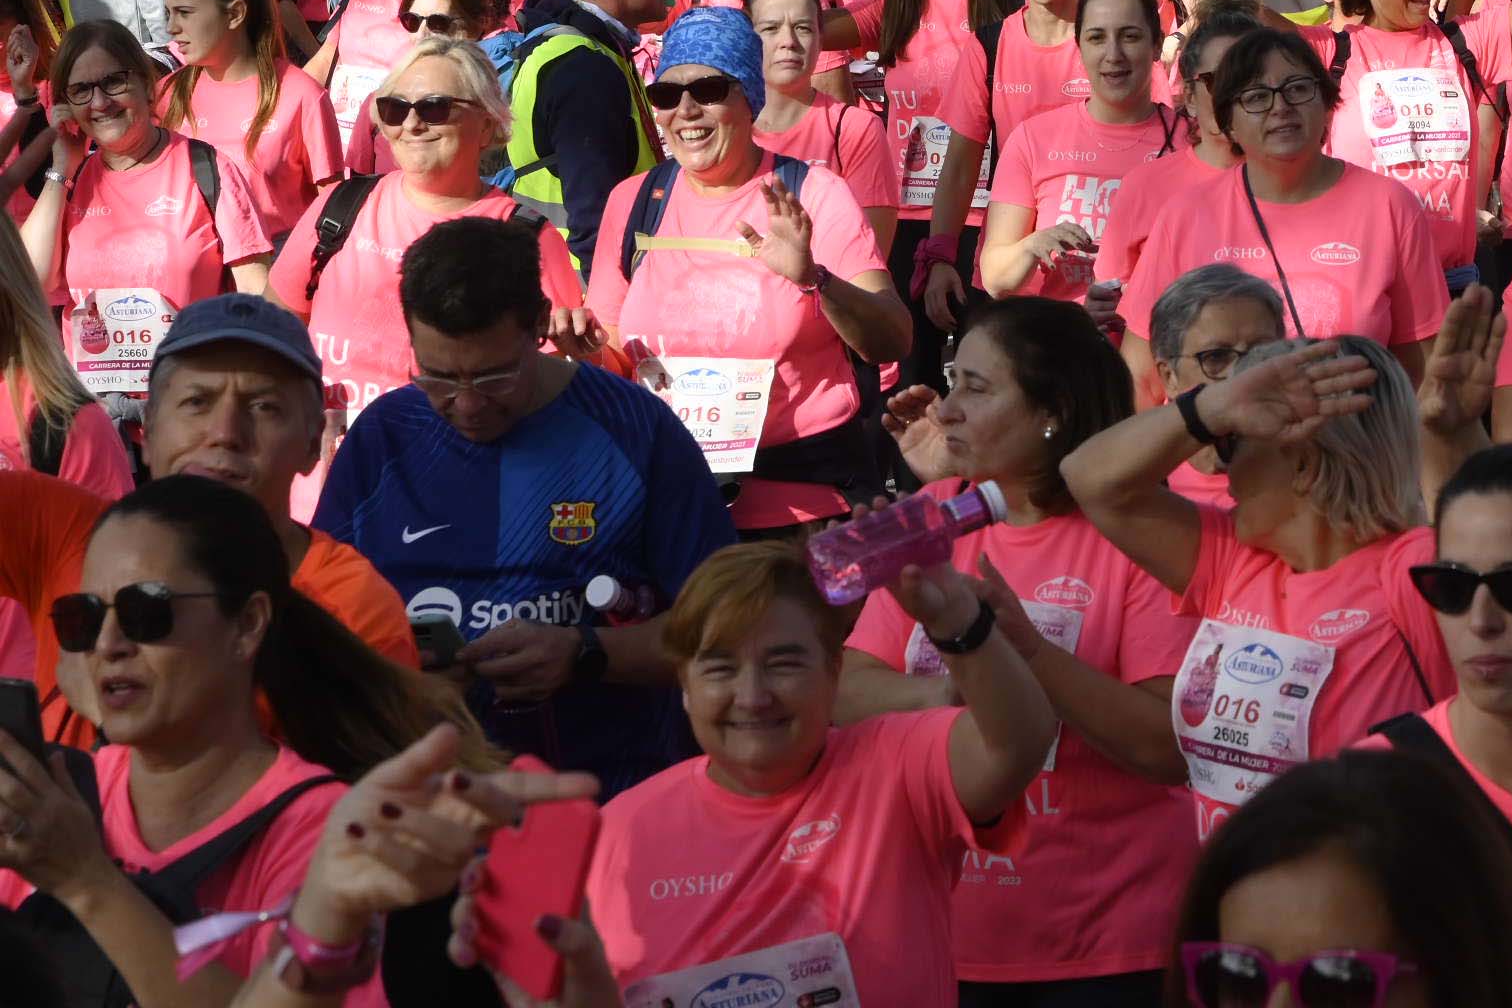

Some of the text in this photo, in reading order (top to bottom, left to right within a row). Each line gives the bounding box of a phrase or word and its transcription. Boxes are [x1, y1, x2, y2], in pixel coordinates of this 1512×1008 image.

[892, 90, 917, 111] TU
[1400, 102, 1434, 118] 016
[1047, 150, 1097, 163] OYSHO
[1214, 246, 1267, 262] OYSHO
[1313, 251, 1359, 262] ASTURIANA
[107, 303, 156, 319] ASTURIANA
[113, 329, 152, 345] 016
[117, 348, 148, 359] 25660
[316, 333, 349, 365] TU
[89, 362, 121, 371] CARRERA
[122, 362, 130, 370] DE
[131, 362, 137, 370] LA
[87, 376, 122, 386] OYSHO
[677, 406, 721, 423] 016
[1225, 655, 1282, 680] ASTURIANA
[1213, 695, 1261, 725] 016
[1213, 725, 1250, 747] 26025
[1241, 753, 1270, 770] MUJER
[650, 872, 734, 902] OYSHO
[996, 876, 1022, 886] 2023
[791, 964, 833, 983] SUMA
